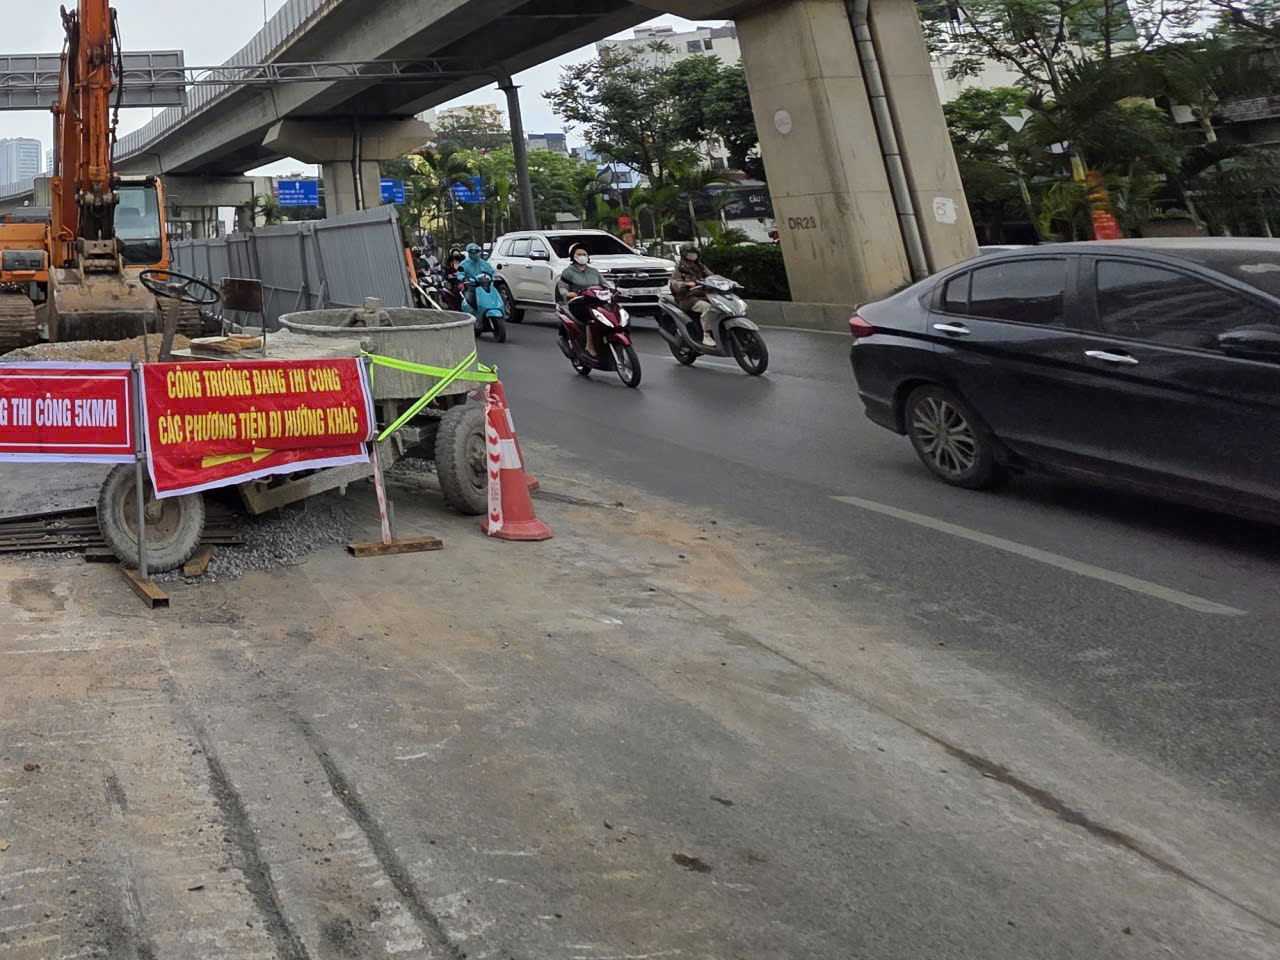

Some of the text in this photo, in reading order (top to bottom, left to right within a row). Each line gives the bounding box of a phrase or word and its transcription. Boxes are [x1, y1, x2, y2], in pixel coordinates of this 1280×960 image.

[167, 365, 202, 399] CÔNG
[203, 363, 252, 397] TRƯỜNG
[252, 368, 286, 395] ĐANG
[288, 368, 307, 393] THI
[11, 397, 32, 426] THI
[35, 392, 71, 427] CÔNG
[74, 398, 117, 427] 5KM/H
[158, 401, 359, 445] CÁC PHƯƠNG TIỆN ĐI HƯỚNG KHÁC
